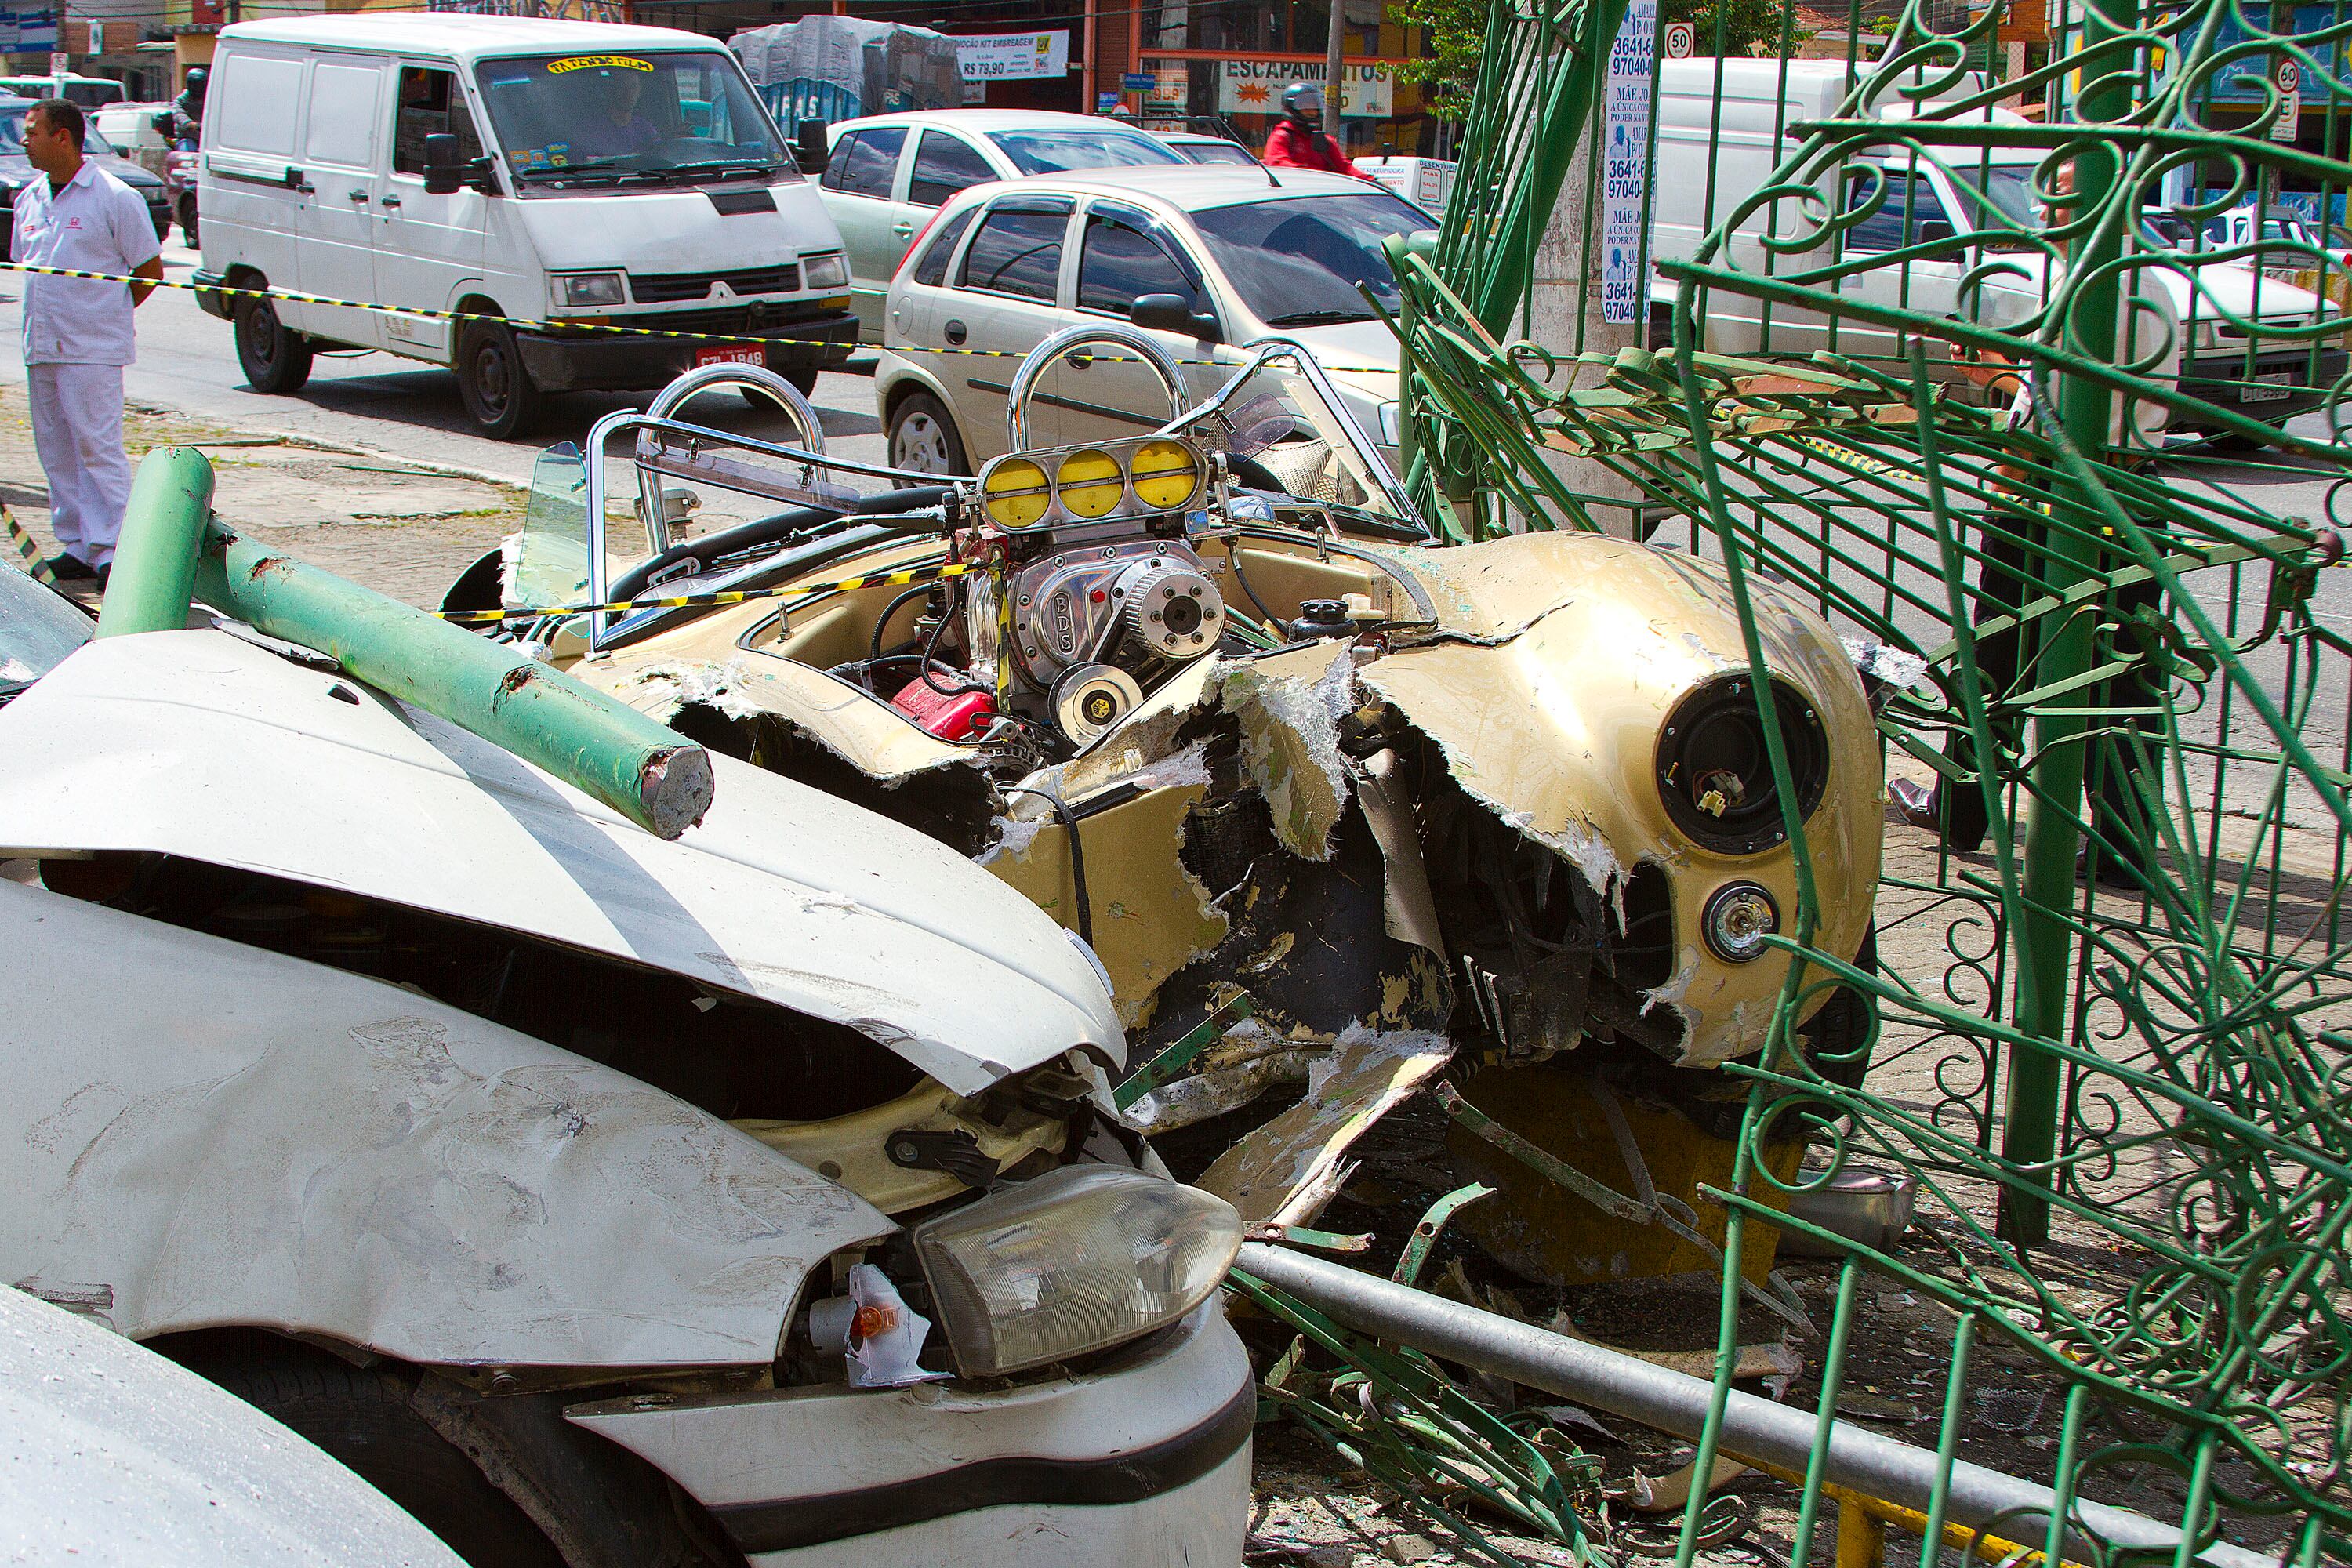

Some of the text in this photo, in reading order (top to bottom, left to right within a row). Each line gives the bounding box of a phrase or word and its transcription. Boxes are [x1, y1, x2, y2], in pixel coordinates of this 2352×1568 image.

[953, 37, 1034, 50] MOÇÃO KIT EMBREAGEM
[1613, 37, 1654, 56] 3641-6
[1672, 34, 1686, 48] 50
[978, 62, 1004, 77] 79,90
[1227, 60, 1387, 82] ESCAPAMTOS
[1613, 56, 1653, 76] 97040-0
[2281, 68, 2296, 82] 60
[1617, 84, 1650, 101] MÃE JO
[1610, 113, 1632, 122] PODER
[1609, 160, 1646, 179] 3641-6
[1608, 180, 1642, 199] 97040-
[1613, 207, 1632, 224] MÃE
[1607, 236, 1628, 245] PODER
[1055, 597, 1072, 649] BDS
